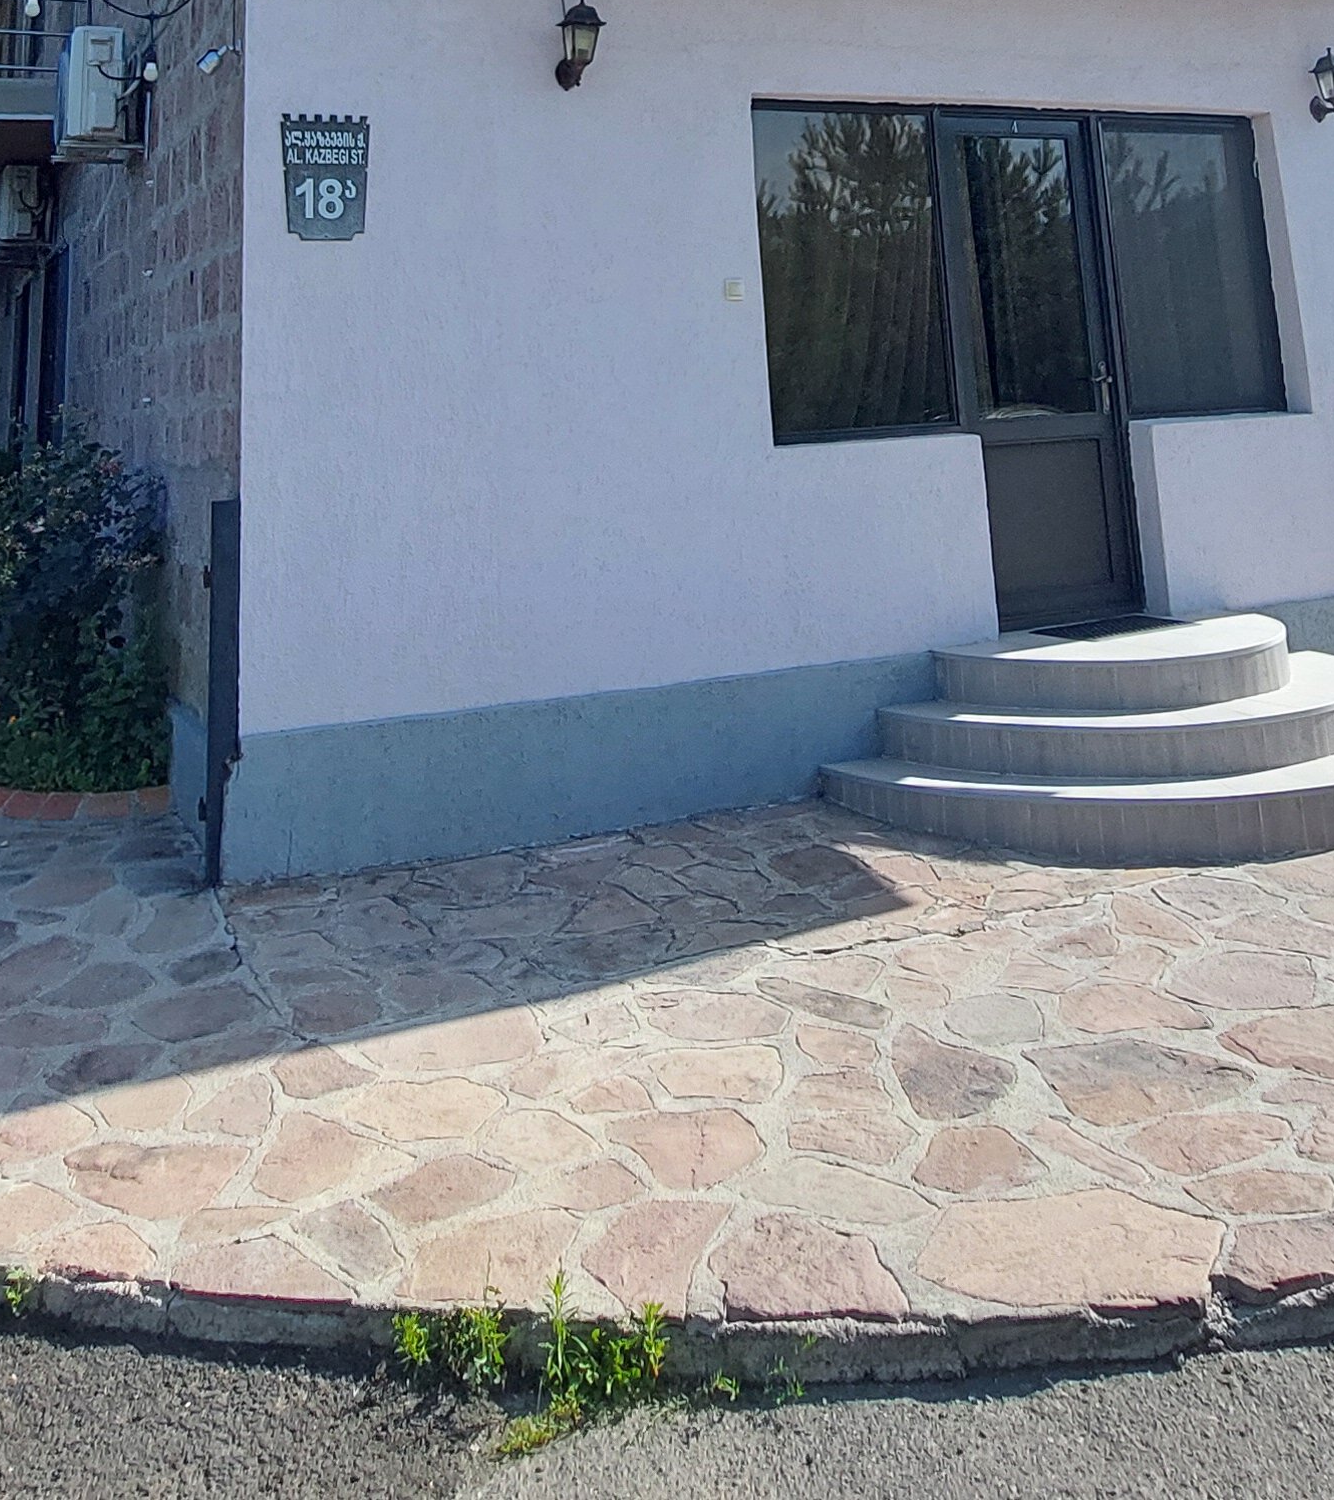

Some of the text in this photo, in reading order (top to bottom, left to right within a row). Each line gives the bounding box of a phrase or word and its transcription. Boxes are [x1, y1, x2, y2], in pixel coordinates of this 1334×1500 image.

[286, 148, 365, 165] AL. KAZBEGI ST.
